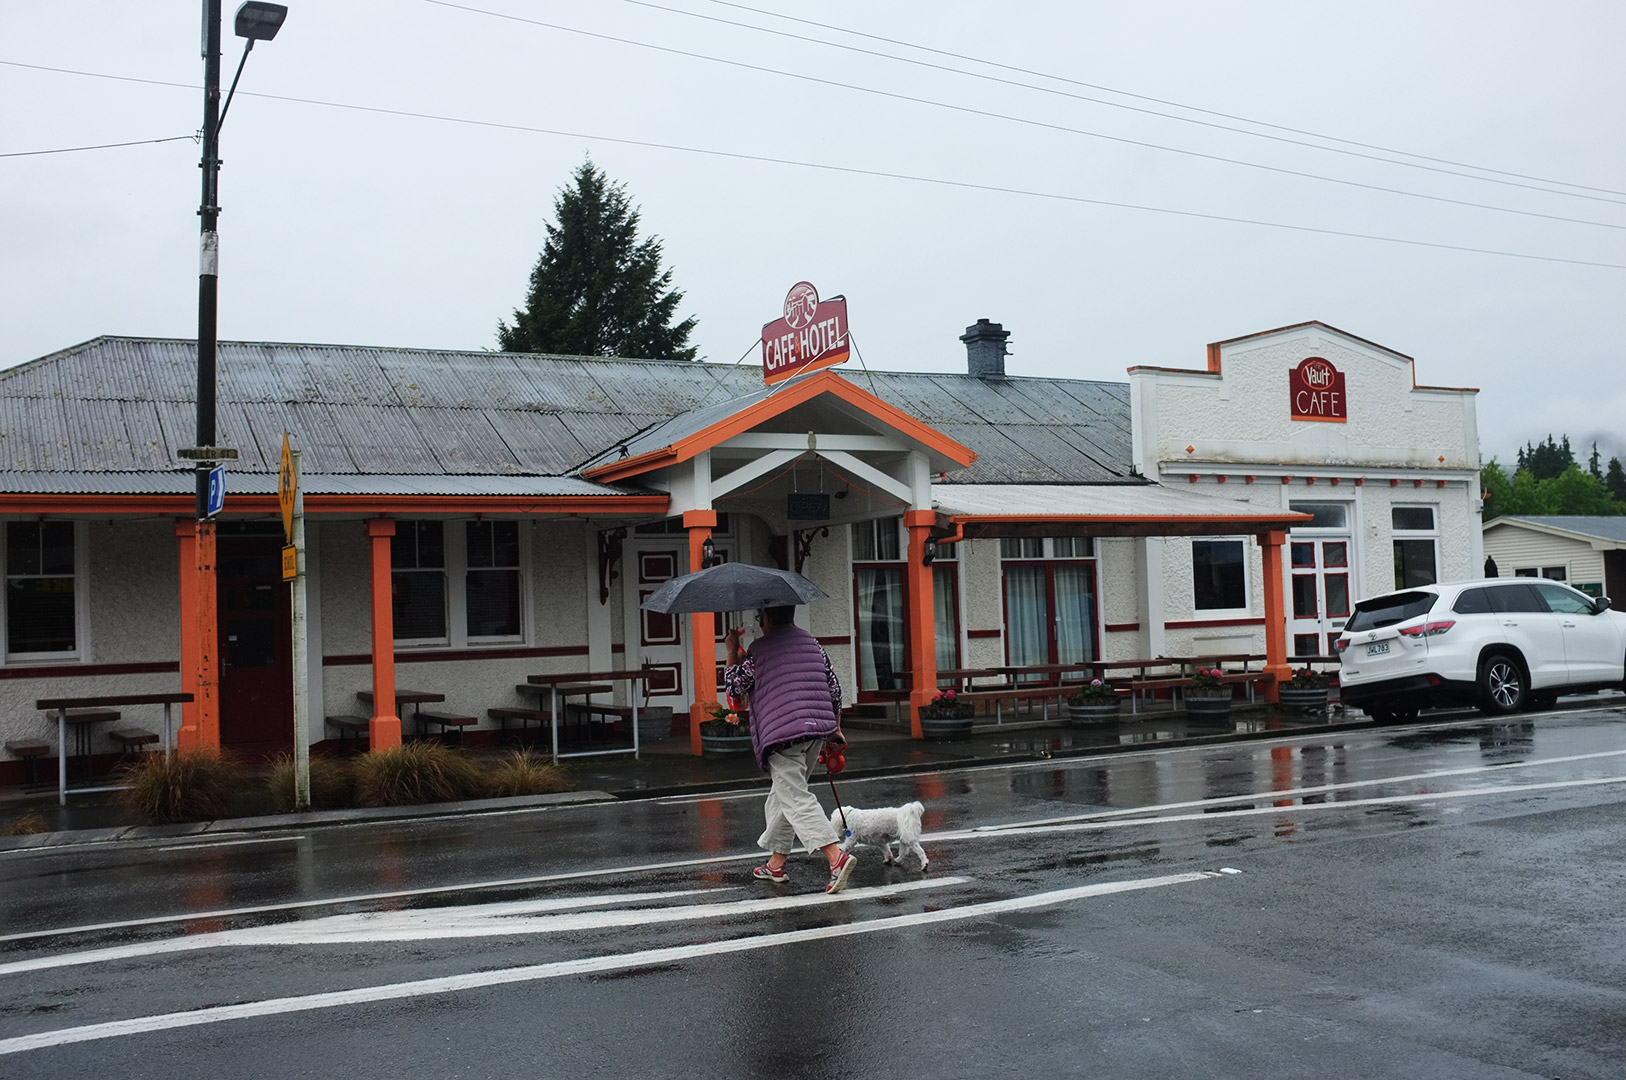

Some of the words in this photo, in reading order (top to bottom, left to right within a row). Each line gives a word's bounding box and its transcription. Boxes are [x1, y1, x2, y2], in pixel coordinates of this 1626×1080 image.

[766, 332, 796, 370] CAFE
[795, 336, 801, 354] &
[800, 316, 845, 359] HOTEL
[1305, 365, 1330, 386] Vault
[1296, 390, 1340, 416] CAFE
[220, 449, 231, 459] ST
[210, 479, 217, 505] P
